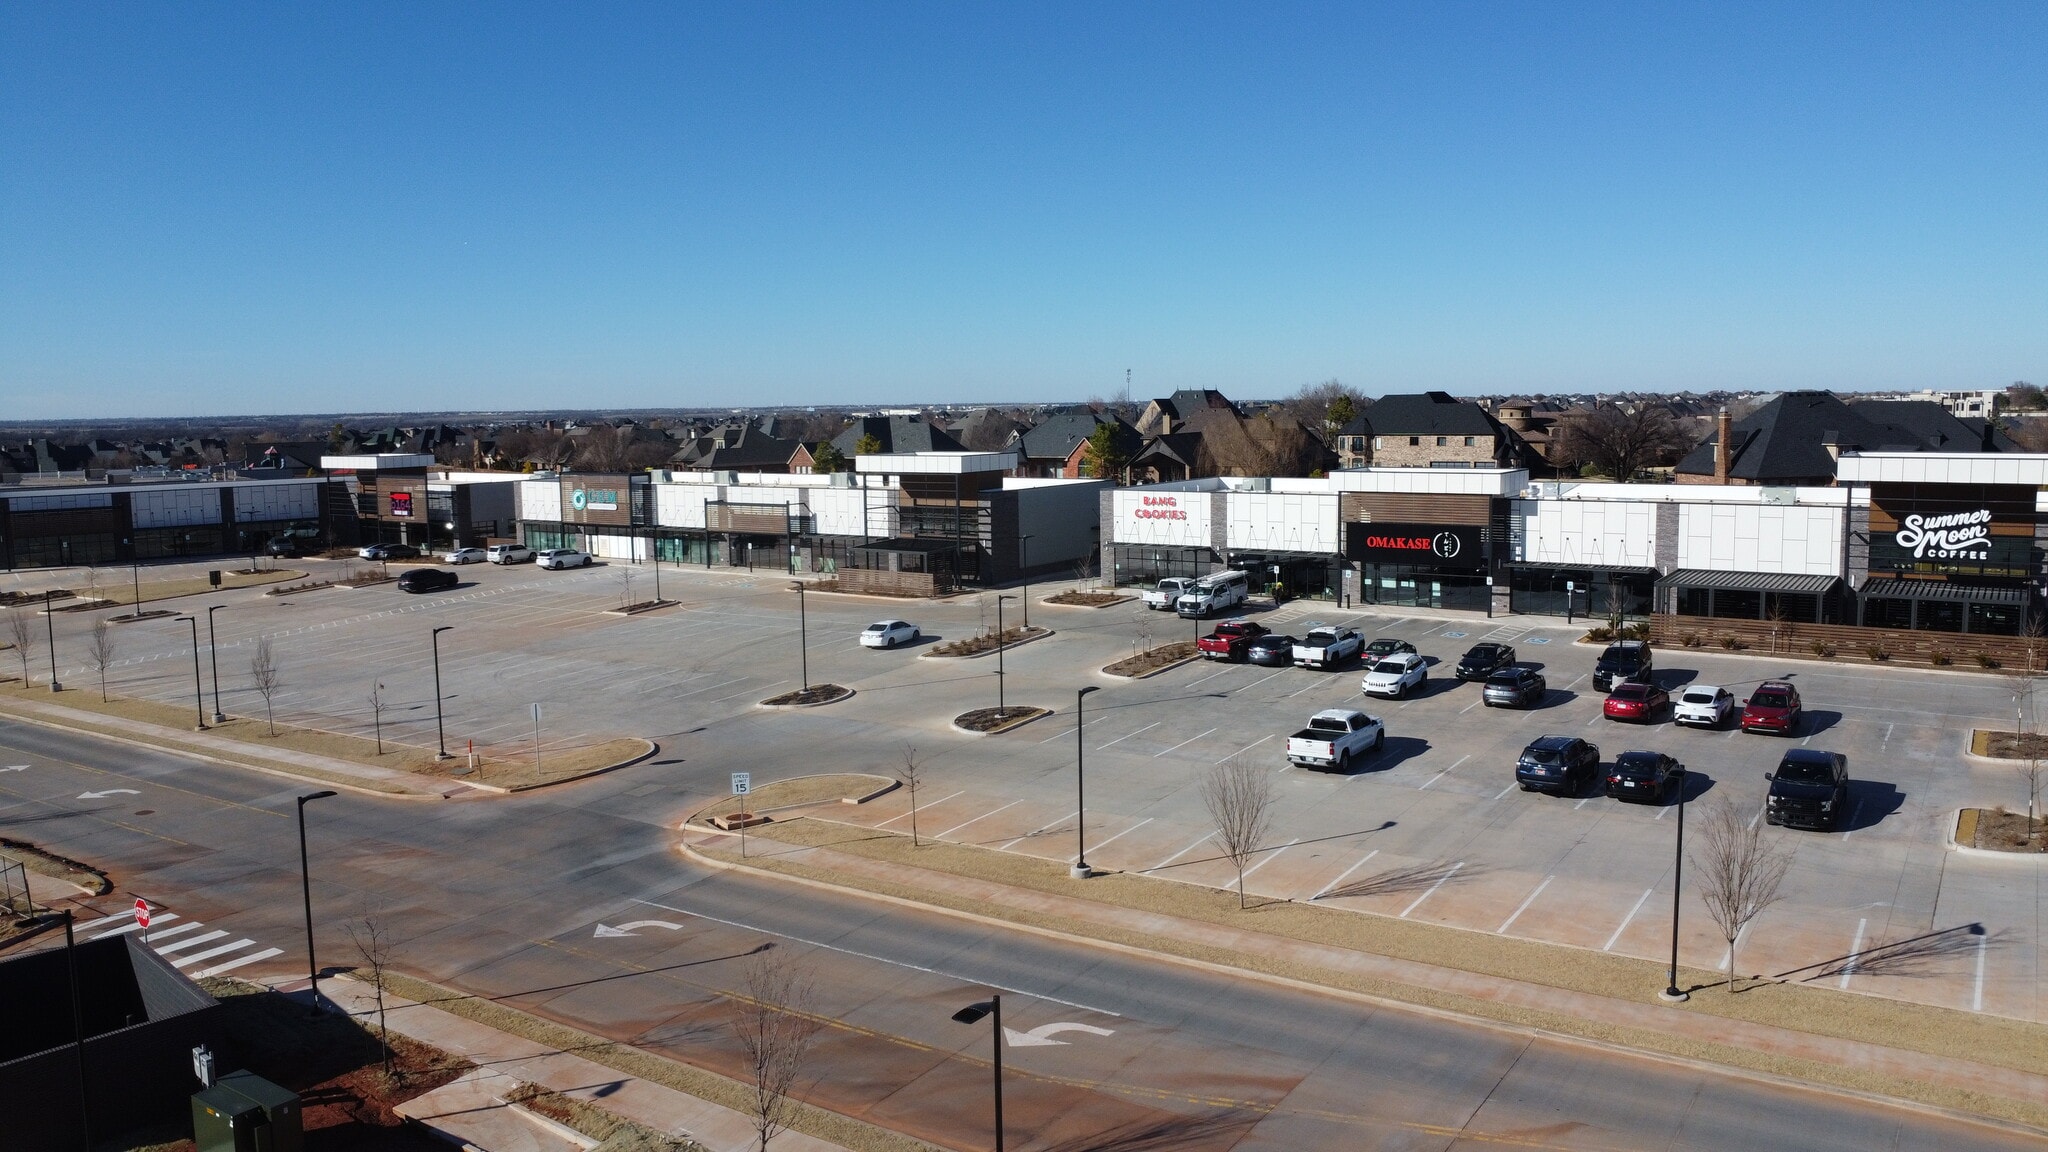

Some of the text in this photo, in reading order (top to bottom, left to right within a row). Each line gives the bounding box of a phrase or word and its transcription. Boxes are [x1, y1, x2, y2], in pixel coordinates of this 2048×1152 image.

[1143, 496, 1177, 507] BANG
[1135, 509, 1187, 520] COOKIES
[1896, 509, 1992, 548] Summer
[1366, 536, 1431, 550] OMAKASE
[1913, 525, 1992, 558] Moon
[1927, 549, 1987, 560] COFFEE
[735, 783, 747, 792] 15
[136, 907, 149, 920] STOP
